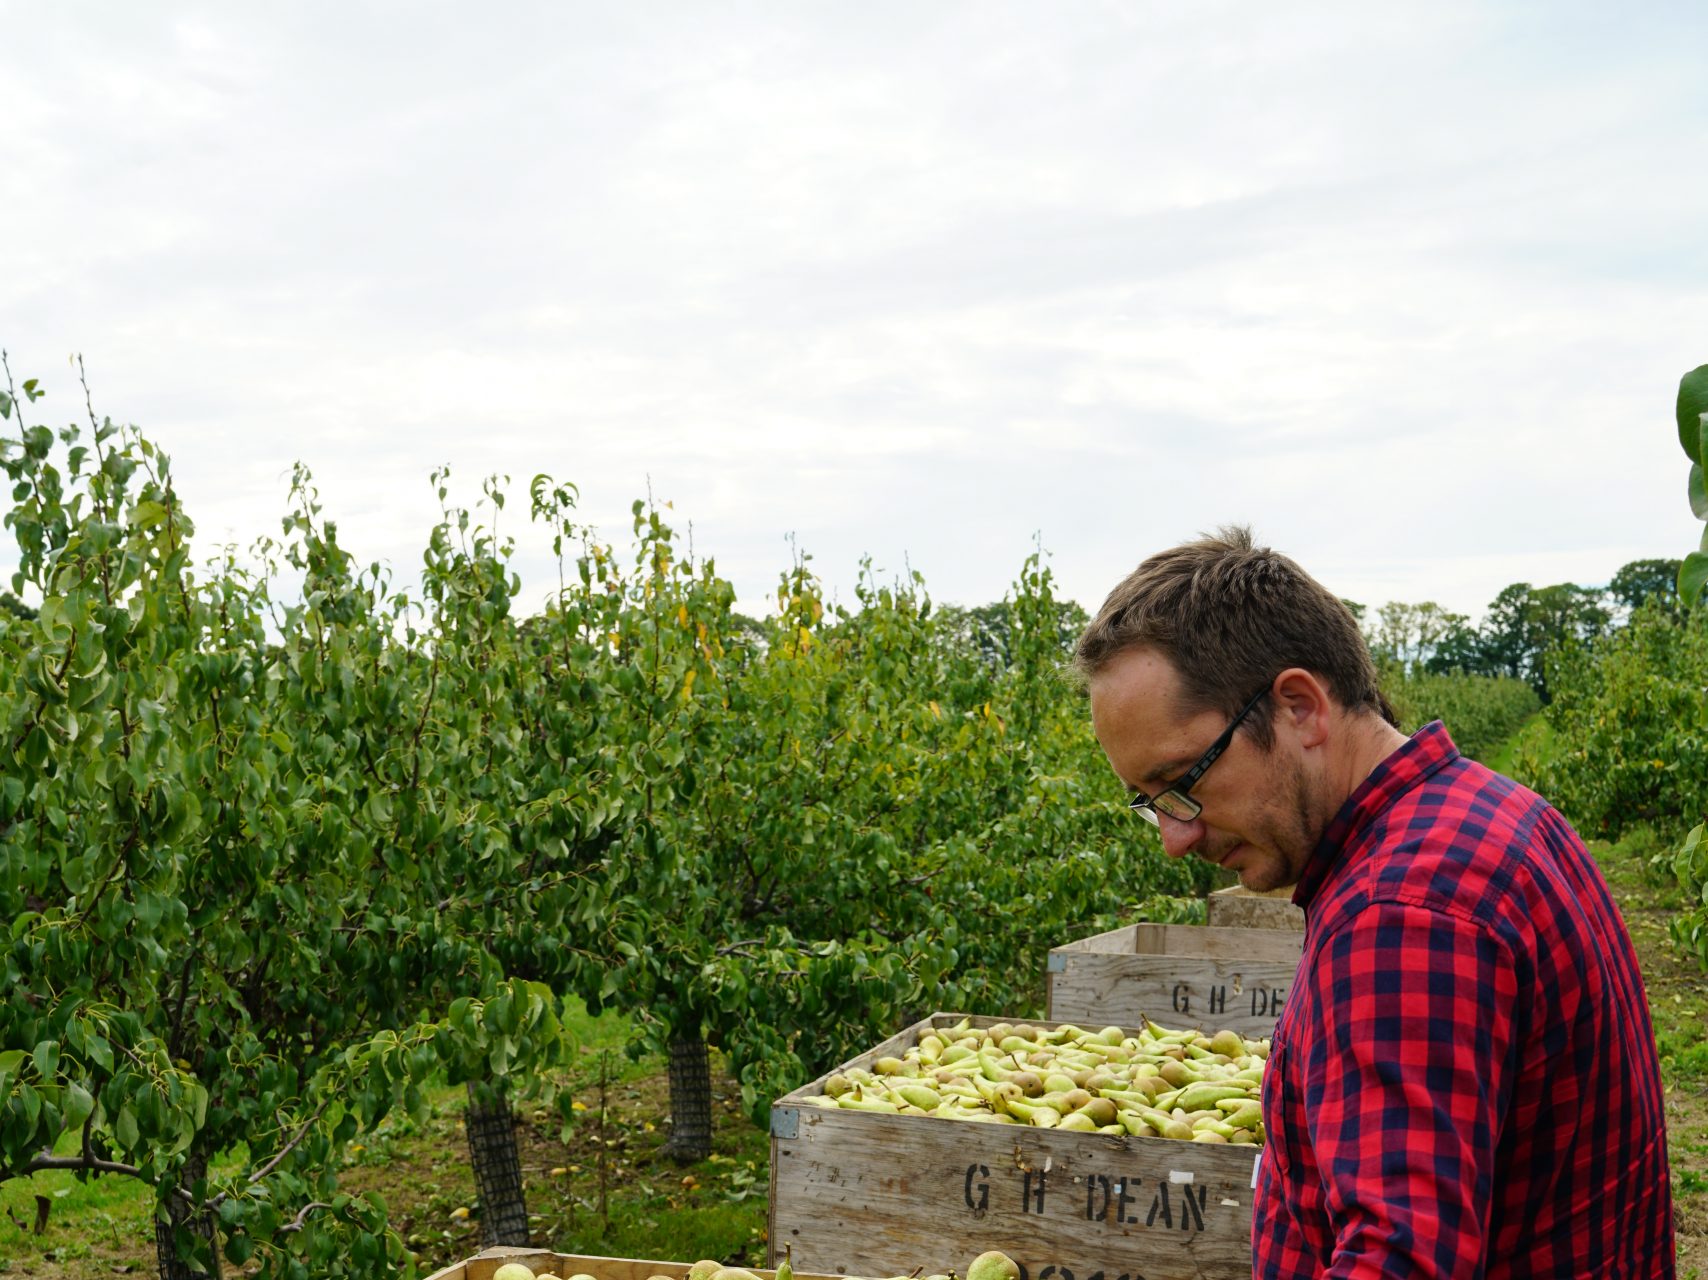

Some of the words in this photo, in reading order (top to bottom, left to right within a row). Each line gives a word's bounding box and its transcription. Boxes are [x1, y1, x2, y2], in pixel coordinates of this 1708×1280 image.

[1173, 985, 1189, 1013] G
[1210, 985, 1225, 1014] H
[964, 1163, 990, 1211] G
[1022, 1169, 1045, 1214] H
[1086, 1173, 1207, 1231] DEAN
